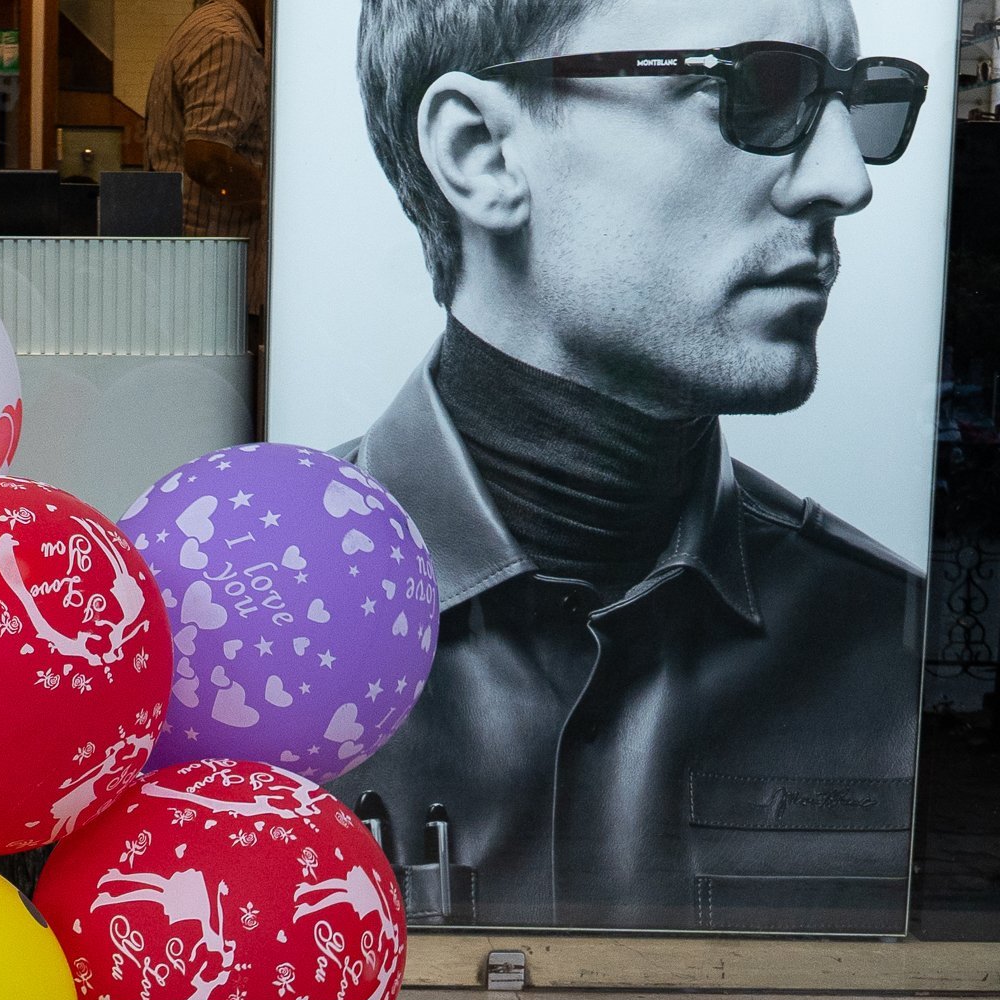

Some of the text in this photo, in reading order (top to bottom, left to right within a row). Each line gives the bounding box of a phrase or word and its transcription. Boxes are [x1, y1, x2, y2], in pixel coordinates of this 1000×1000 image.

[636, 58, 678, 67] MONTBLANC
[41, 534, 92, 575] You
[30, 575, 107, 624] I Love
[203, 561, 258, 619] you
[223, 531, 294, 626] I love
[406, 577, 436, 619] love
[177, 758, 237, 774] You
[186, 768, 245, 794] Love
[109, 915, 145, 980] You
[165, 937, 186, 976] I
[314, 920, 346, 983] You
